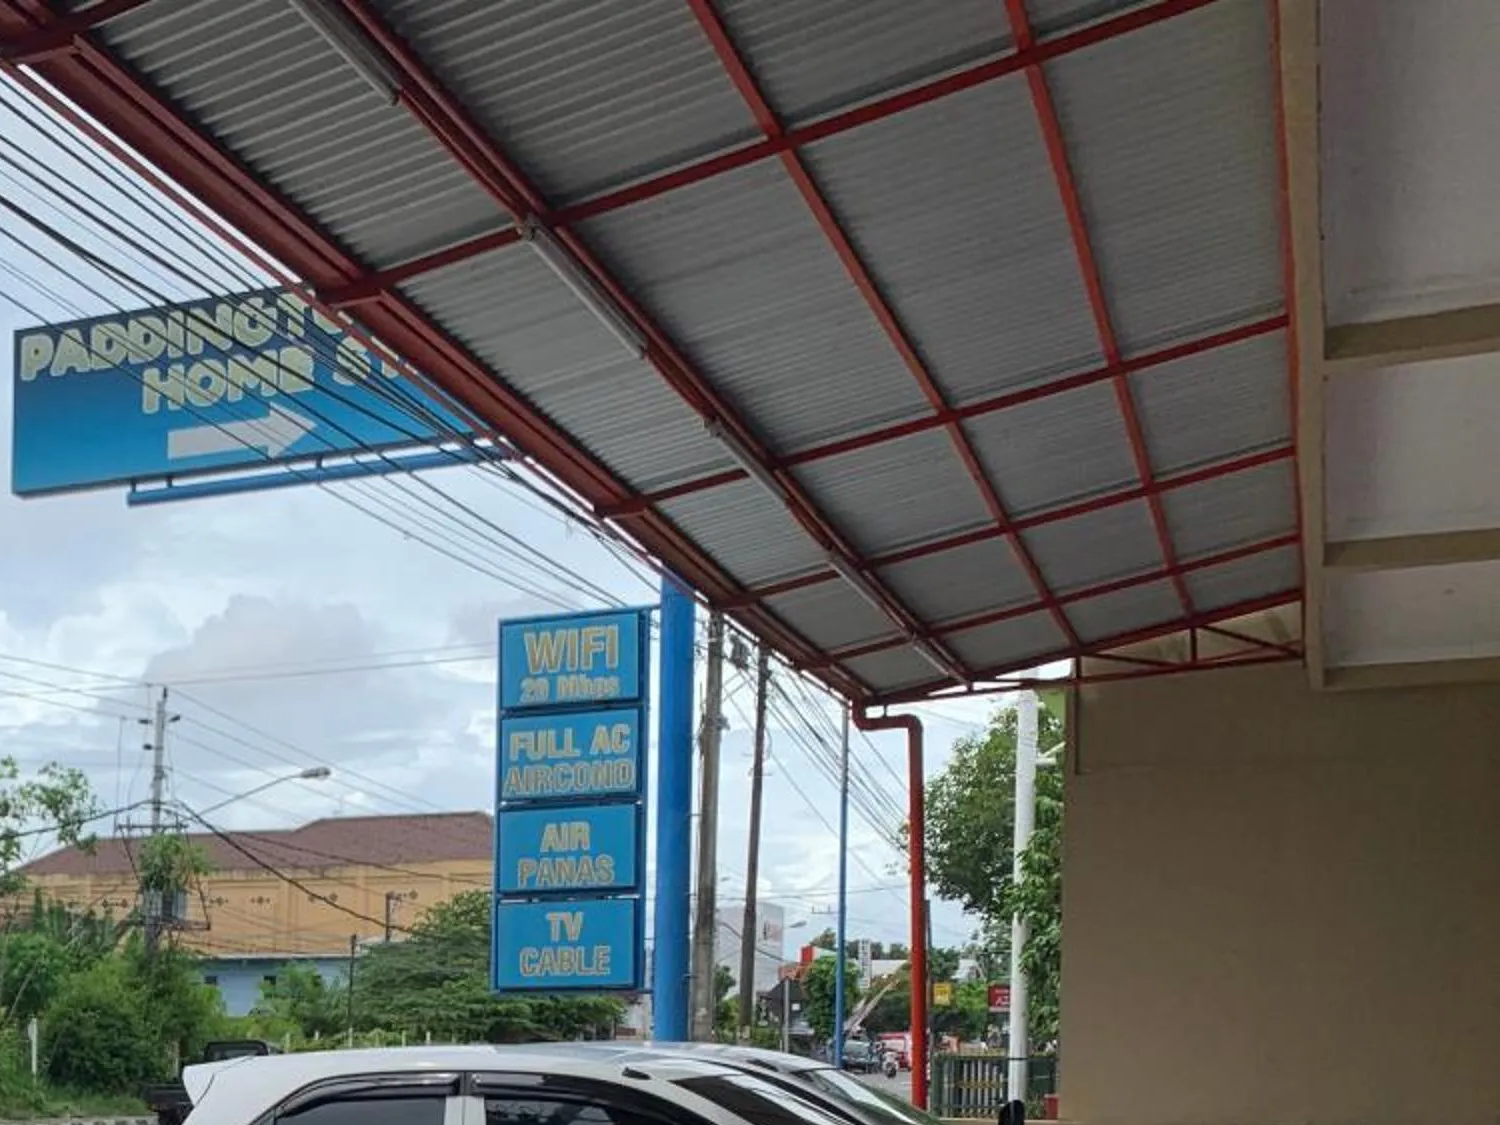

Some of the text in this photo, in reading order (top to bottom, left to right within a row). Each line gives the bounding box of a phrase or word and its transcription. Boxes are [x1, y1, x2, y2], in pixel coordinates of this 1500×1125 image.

[141, 344, 315, 414] HOME
[523, 623, 620, 674] WIFI
[509, 723, 631, 761] FULL AC
[503, 760, 634, 796] AIRCOND
[540, 821, 591, 852] AIR
[517, 855, 614, 888] PANAS
[546, 911, 584, 943] TV
[519, 946, 611, 976] CABLE
